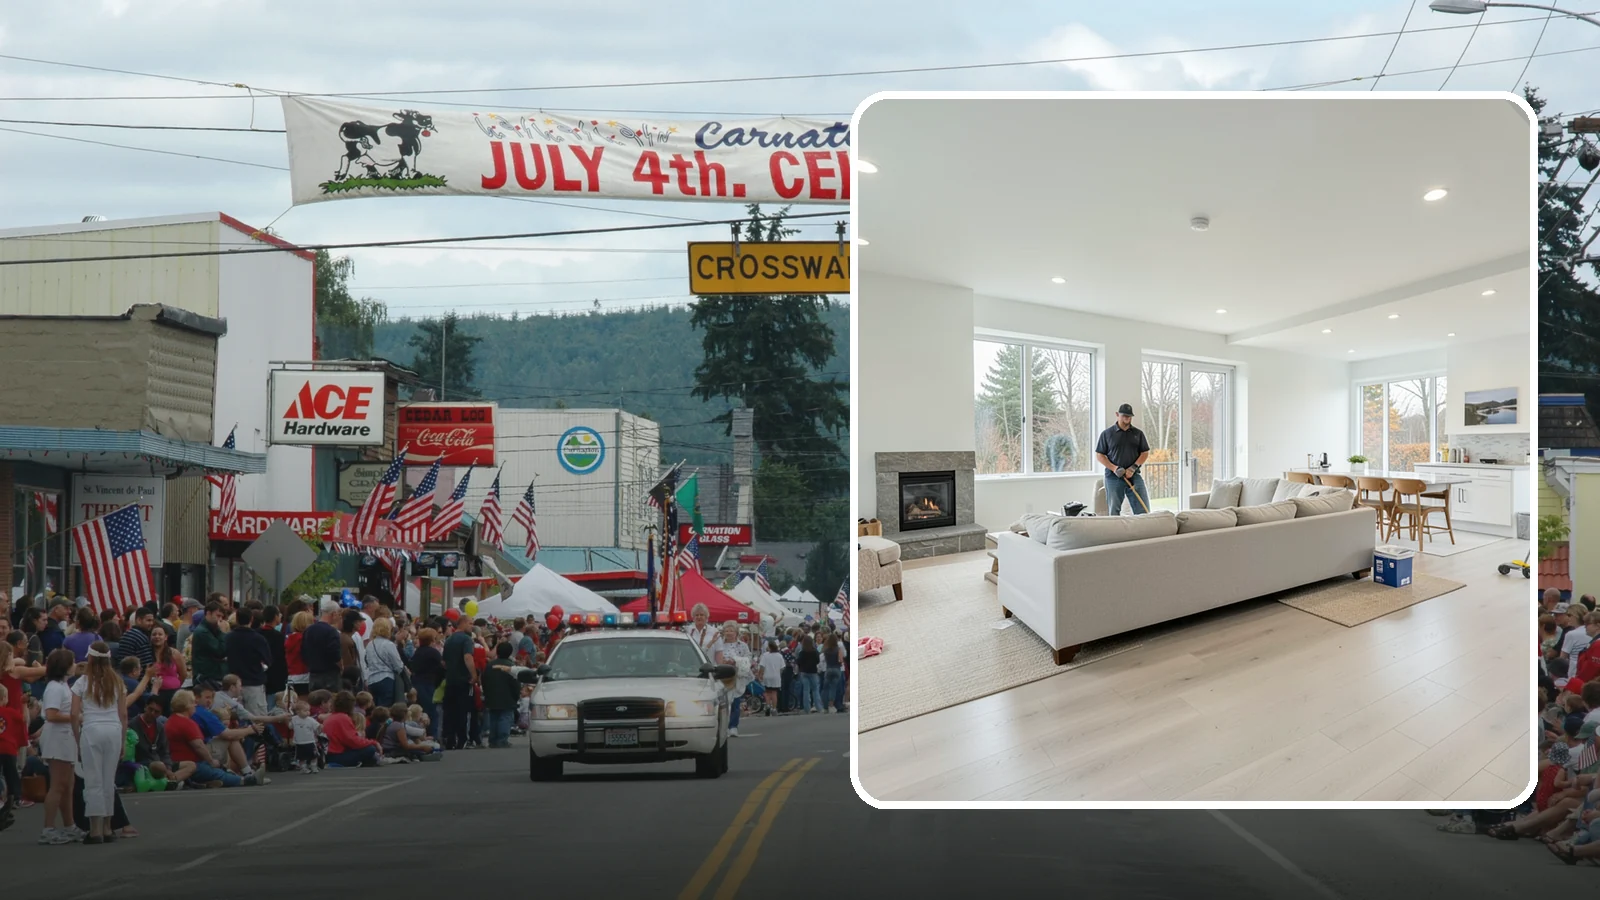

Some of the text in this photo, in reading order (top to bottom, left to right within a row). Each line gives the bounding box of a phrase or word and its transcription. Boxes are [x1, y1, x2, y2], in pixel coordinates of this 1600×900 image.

[481, 141, 604, 192] JULY
[632, 150, 746, 198] 4th.
[697, 254, 850, 280] CROSSWA
[283, 380, 373, 420] ACE
[406, 409, 452, 421] CEDAR
[283, 421, 370, 436] Hardware
[353, 467, 386, 481] Simpl
[96, 485, 124, 495] Vincent
[126, 485, 136, 495] de
[138, 485, 155, 495] Paul
[213, 516, 331, 537] HARDARE
[688, 526, 741, 535] CRNATION
[699, 535, 730, 543] GLASS
